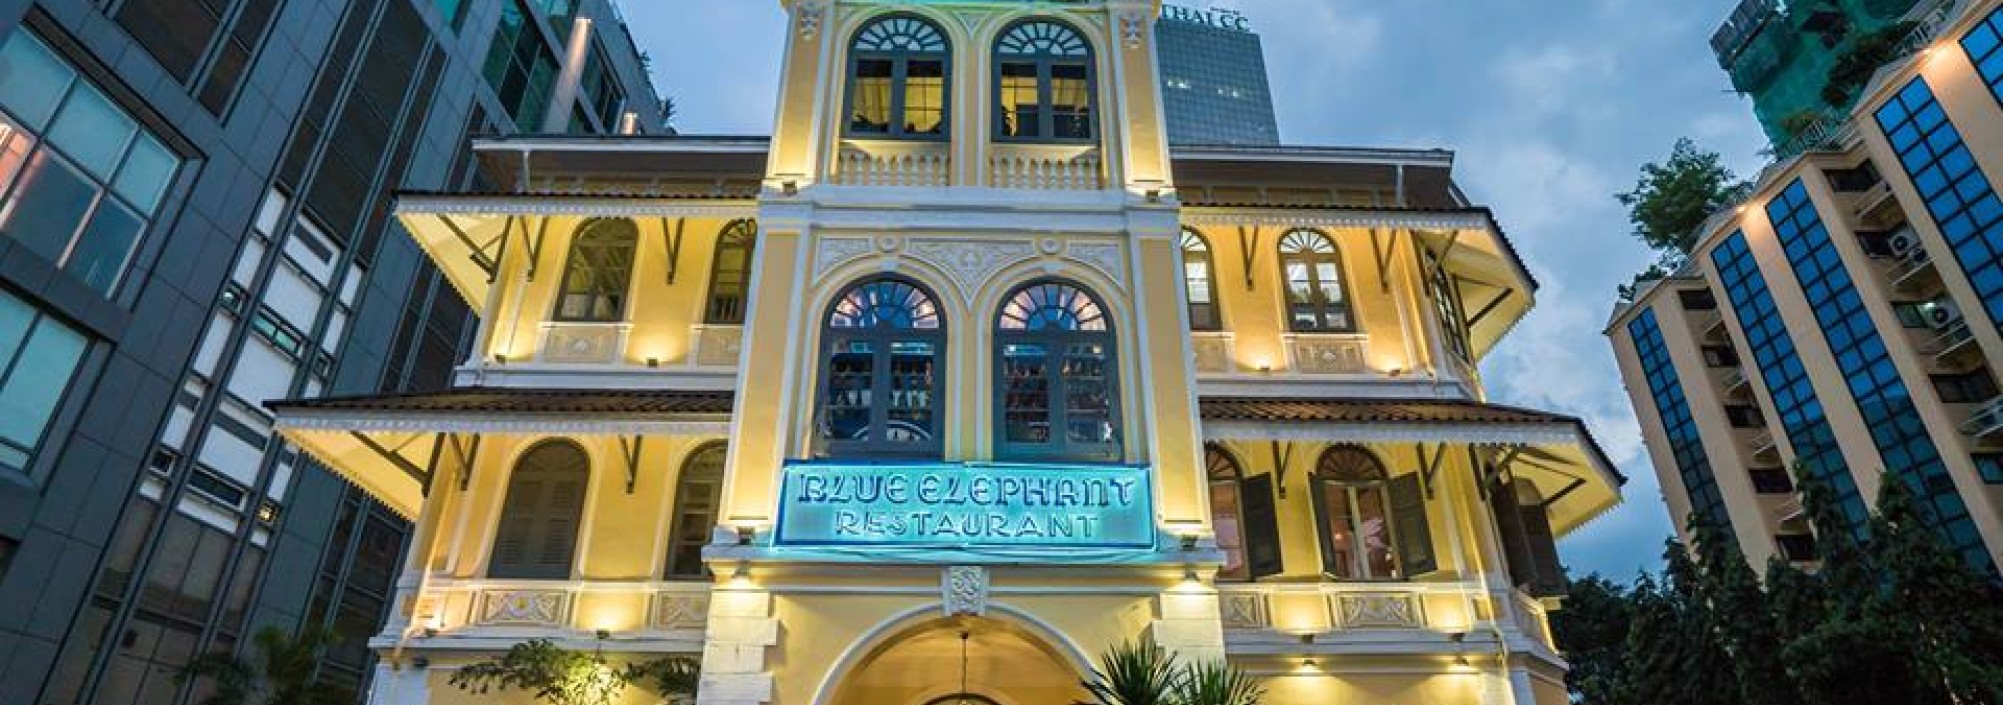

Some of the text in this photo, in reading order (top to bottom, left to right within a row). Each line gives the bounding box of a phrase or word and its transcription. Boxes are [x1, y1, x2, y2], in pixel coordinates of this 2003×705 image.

[798, 473, 1135, 508] BLUE ELEPHANT
[834, 511, 1099, 538] RESTAURANT
